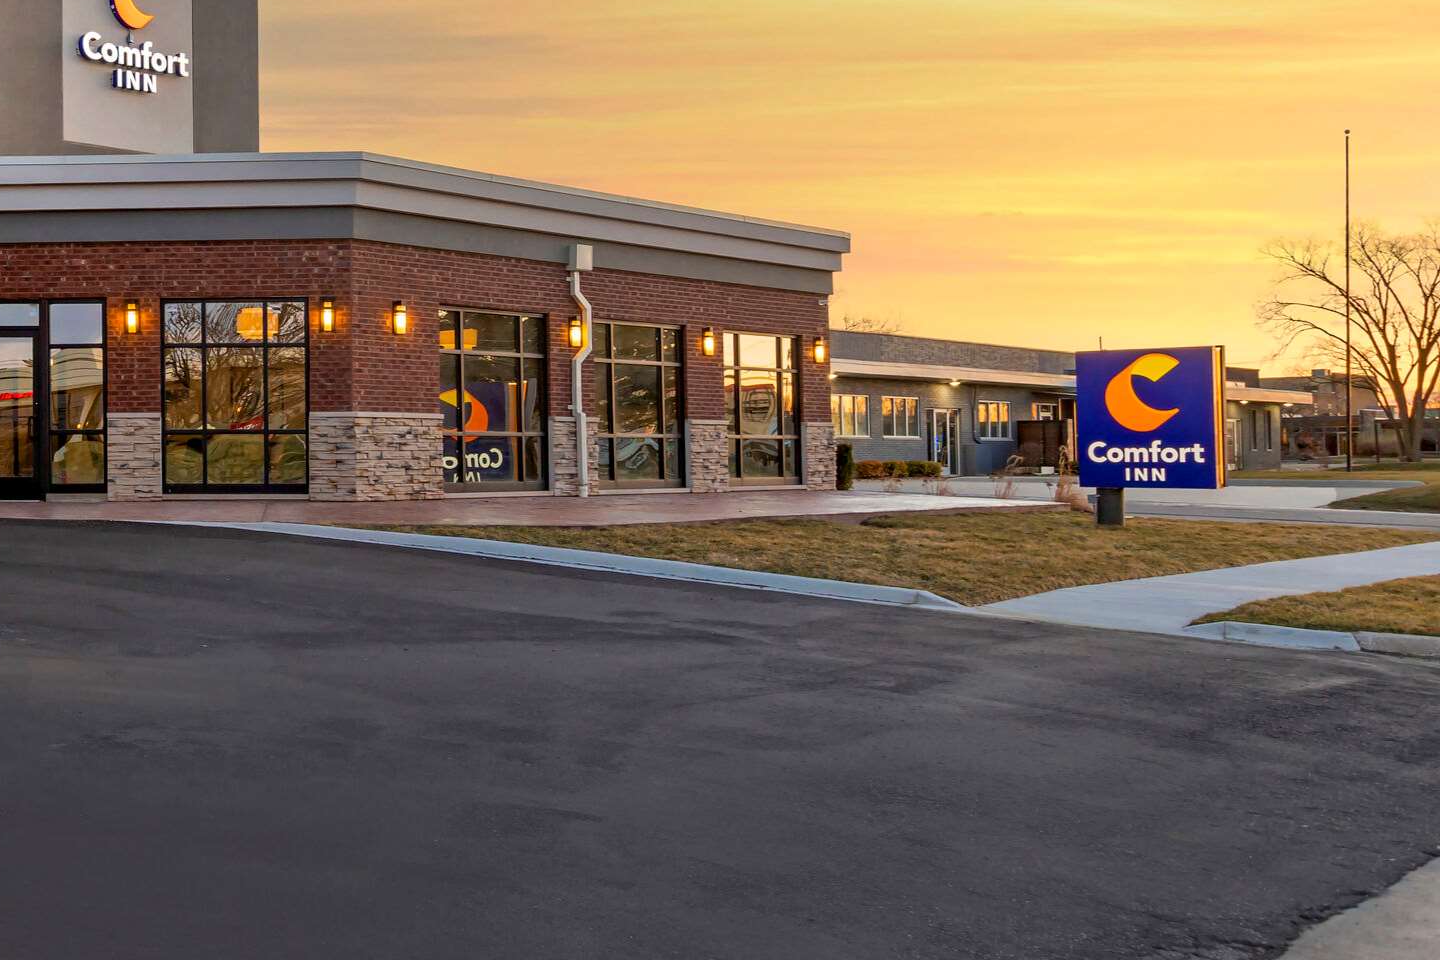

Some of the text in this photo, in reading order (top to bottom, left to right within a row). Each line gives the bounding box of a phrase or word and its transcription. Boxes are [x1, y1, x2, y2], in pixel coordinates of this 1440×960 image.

[79, 31, 189, 77] Comfort
[114, 68, 157, 93] INN
[1087, 440, 1205, 463] Comfort
[1125, 468, 1166, 482] INN
